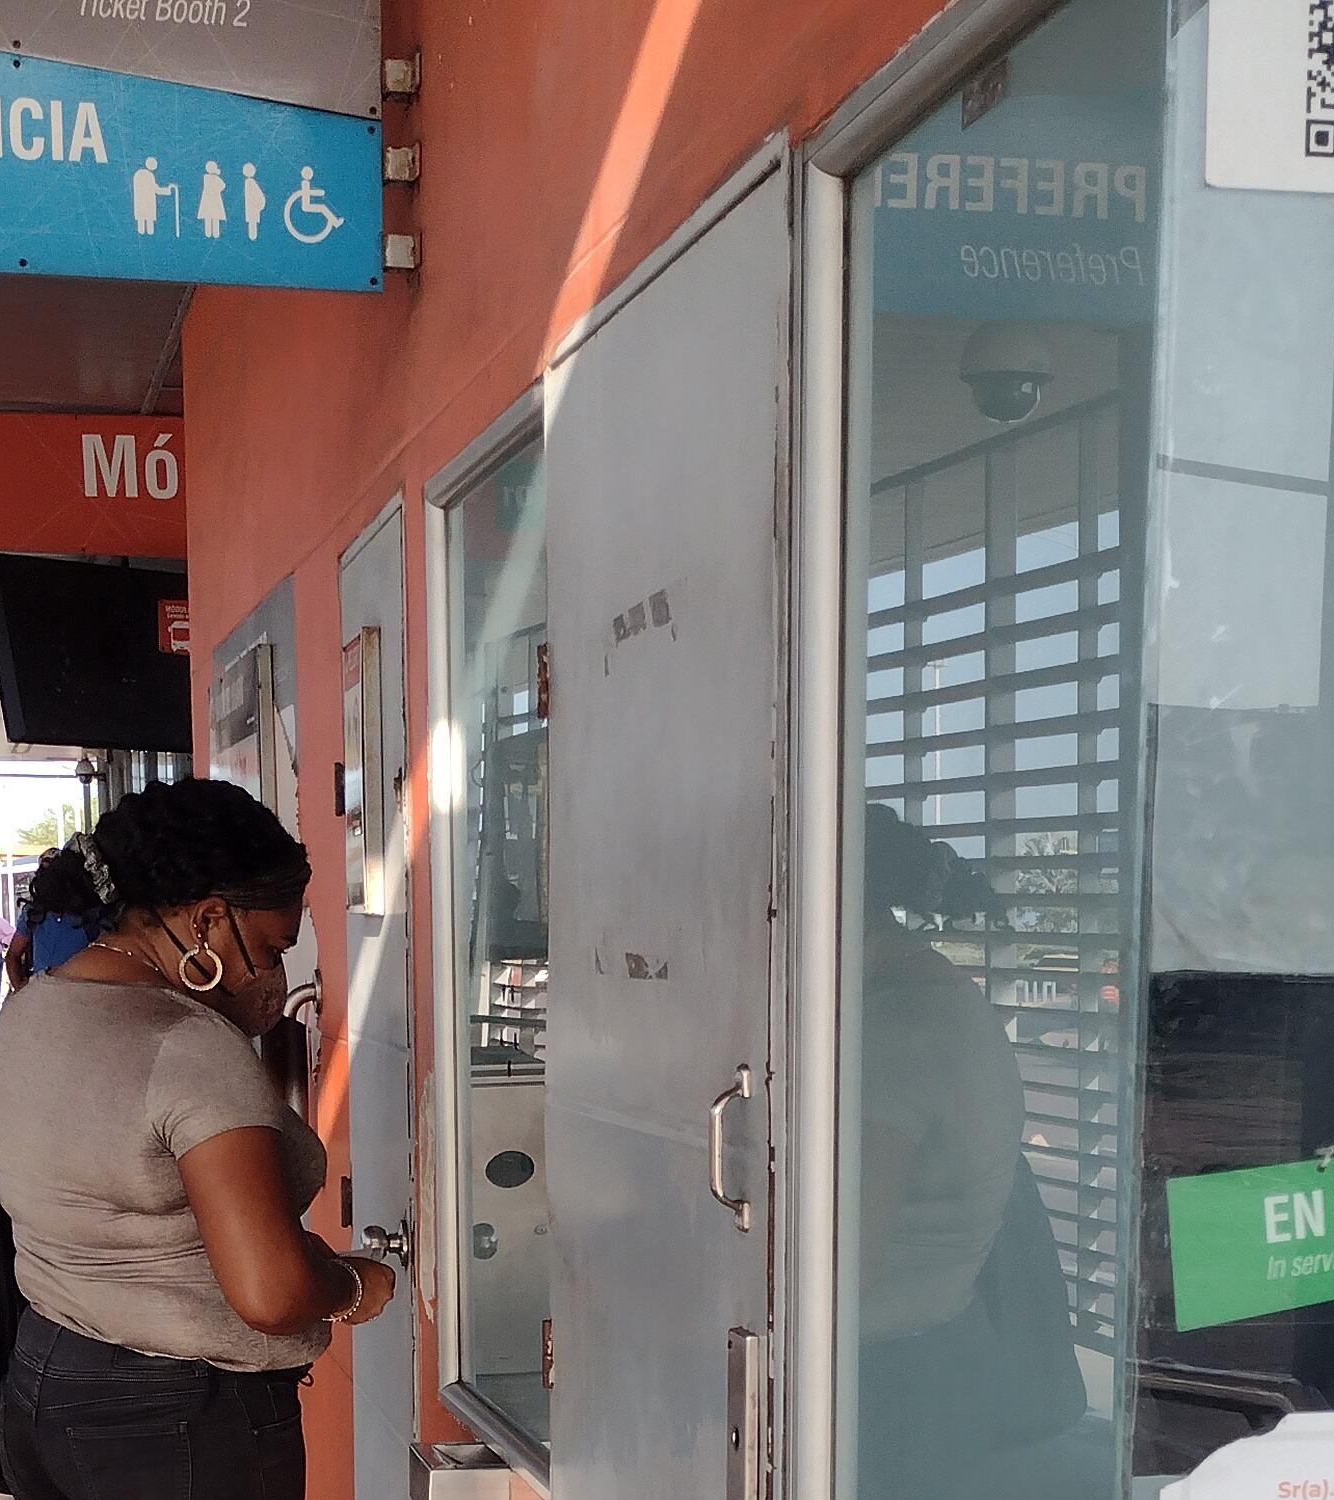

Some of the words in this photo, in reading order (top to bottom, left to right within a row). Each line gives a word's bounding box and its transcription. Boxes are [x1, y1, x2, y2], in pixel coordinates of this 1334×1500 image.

[155, 0, 226, 25] Booth
[233, 0, 251, 27] 2
[82, 433, 179, 500] Mó
[1264, 1188, 1326, 1244] EN
[1267, 1256, 1287, 1280] In
[1278, 1479, 1334, 1500] Sr(a).
